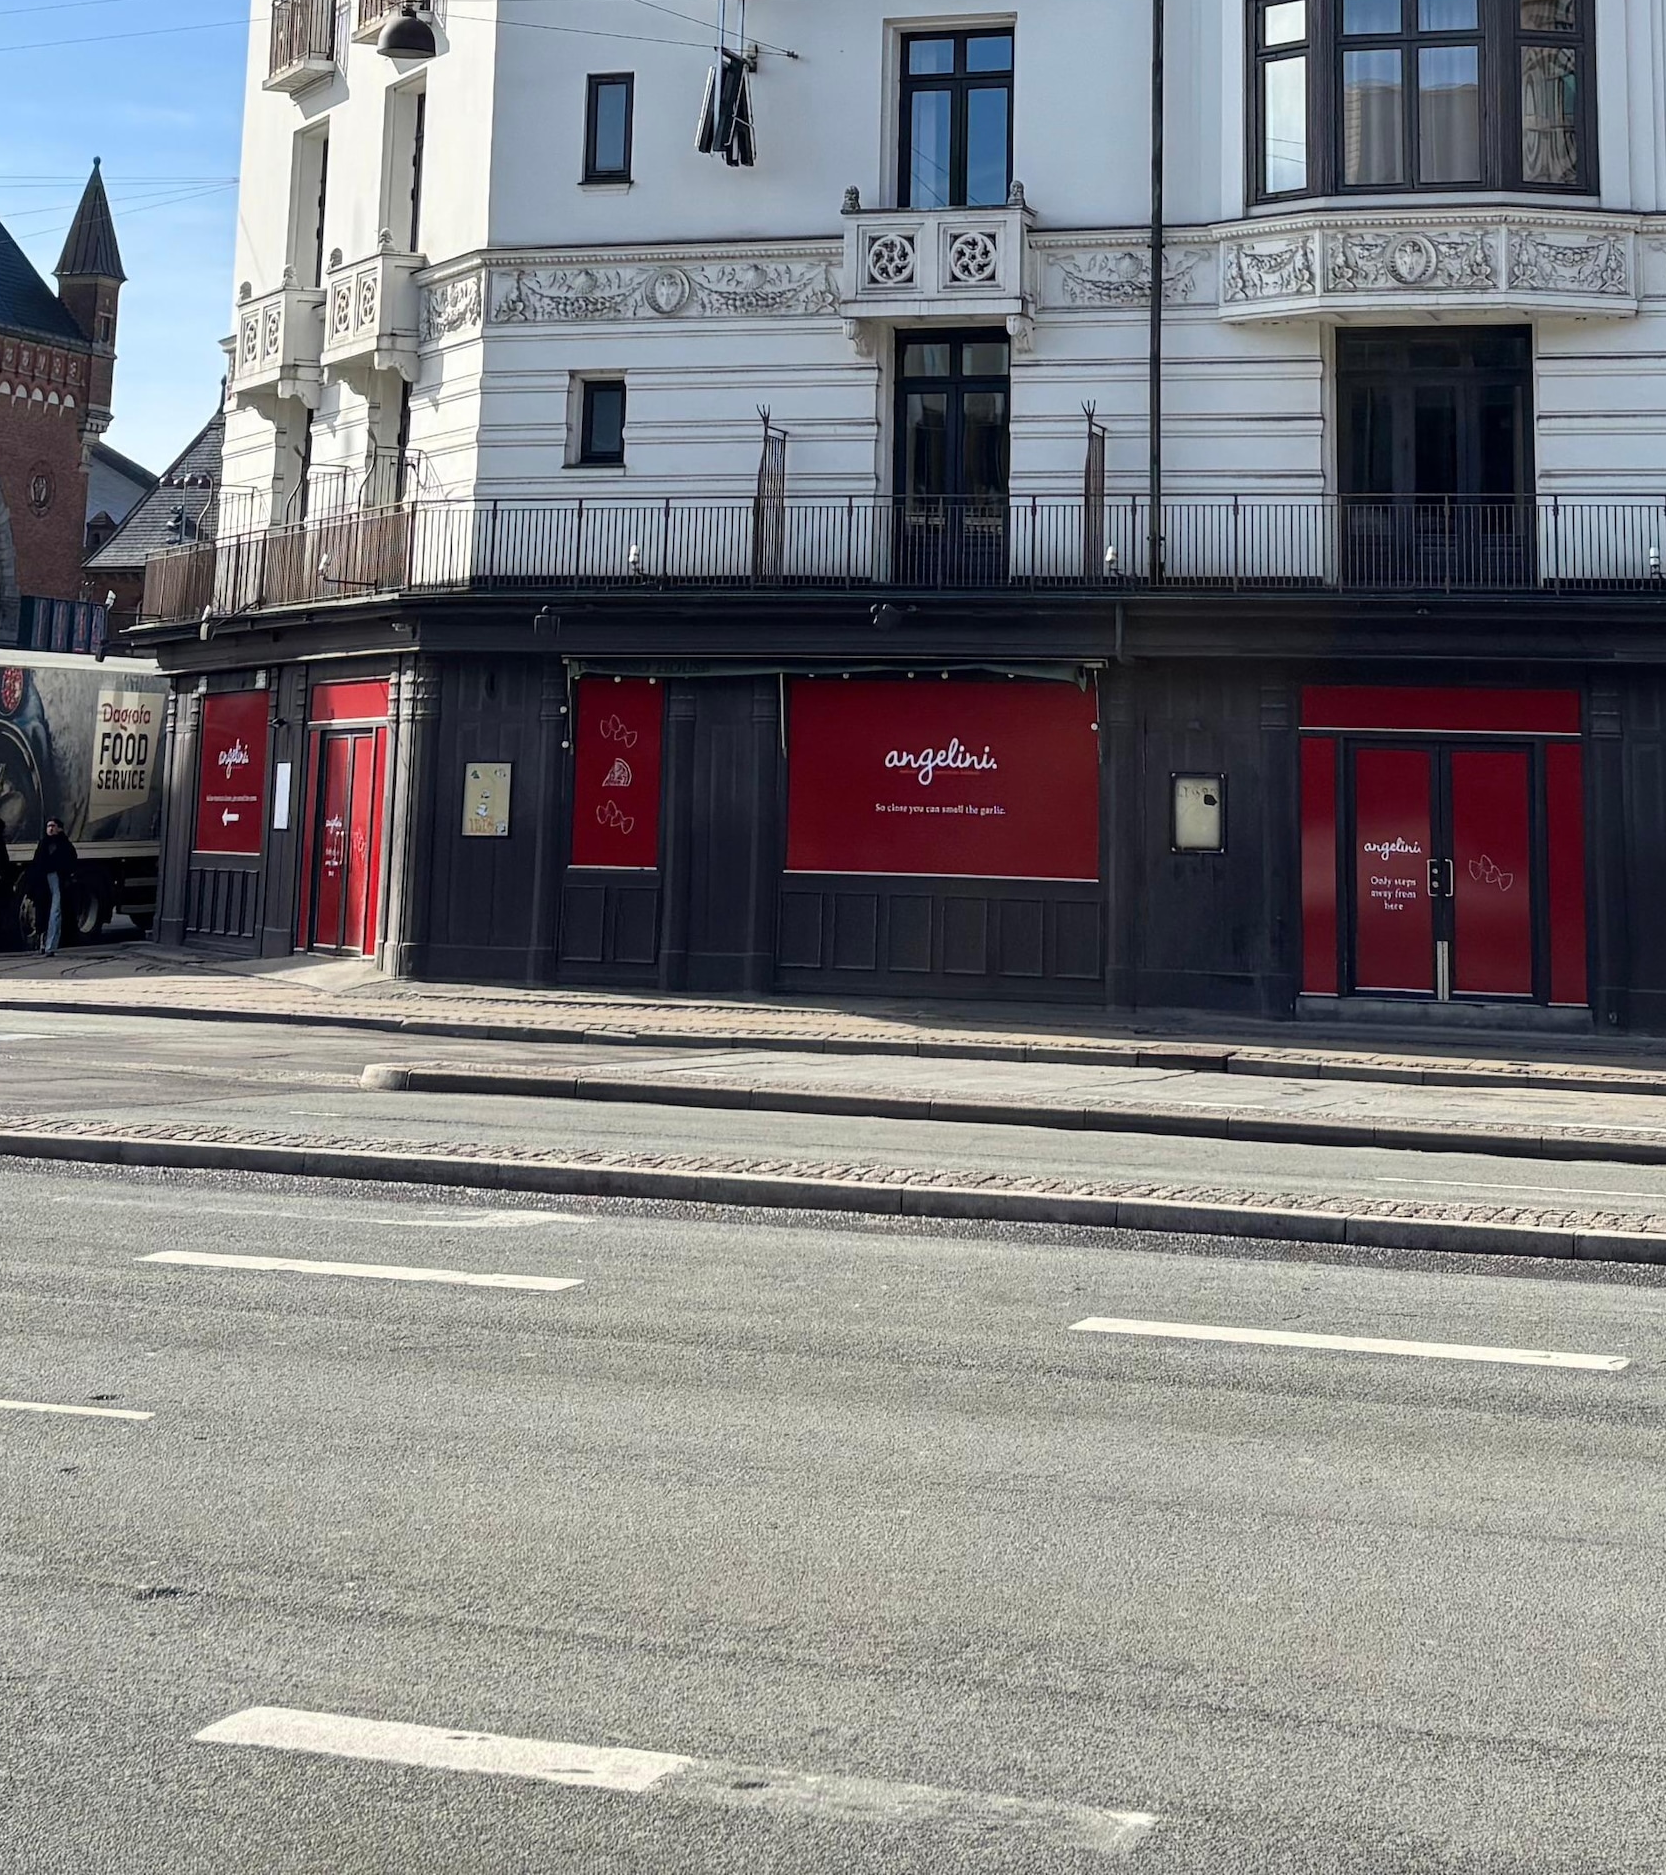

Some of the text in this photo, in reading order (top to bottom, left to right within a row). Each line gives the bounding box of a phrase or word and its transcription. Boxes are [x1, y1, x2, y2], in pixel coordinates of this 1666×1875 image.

[99, 732, 149, 766] FOOD
[884, 737, 998, 786] angelini.
[96, 769, 146, 791] SERVICE
[875, 803, 886, 812] So
[909, 805, 924, 815] you
[965, 805, 978, 815] the
[1370, 875, 1392, 889] Only
[1395, 888, 1417, 899] from
